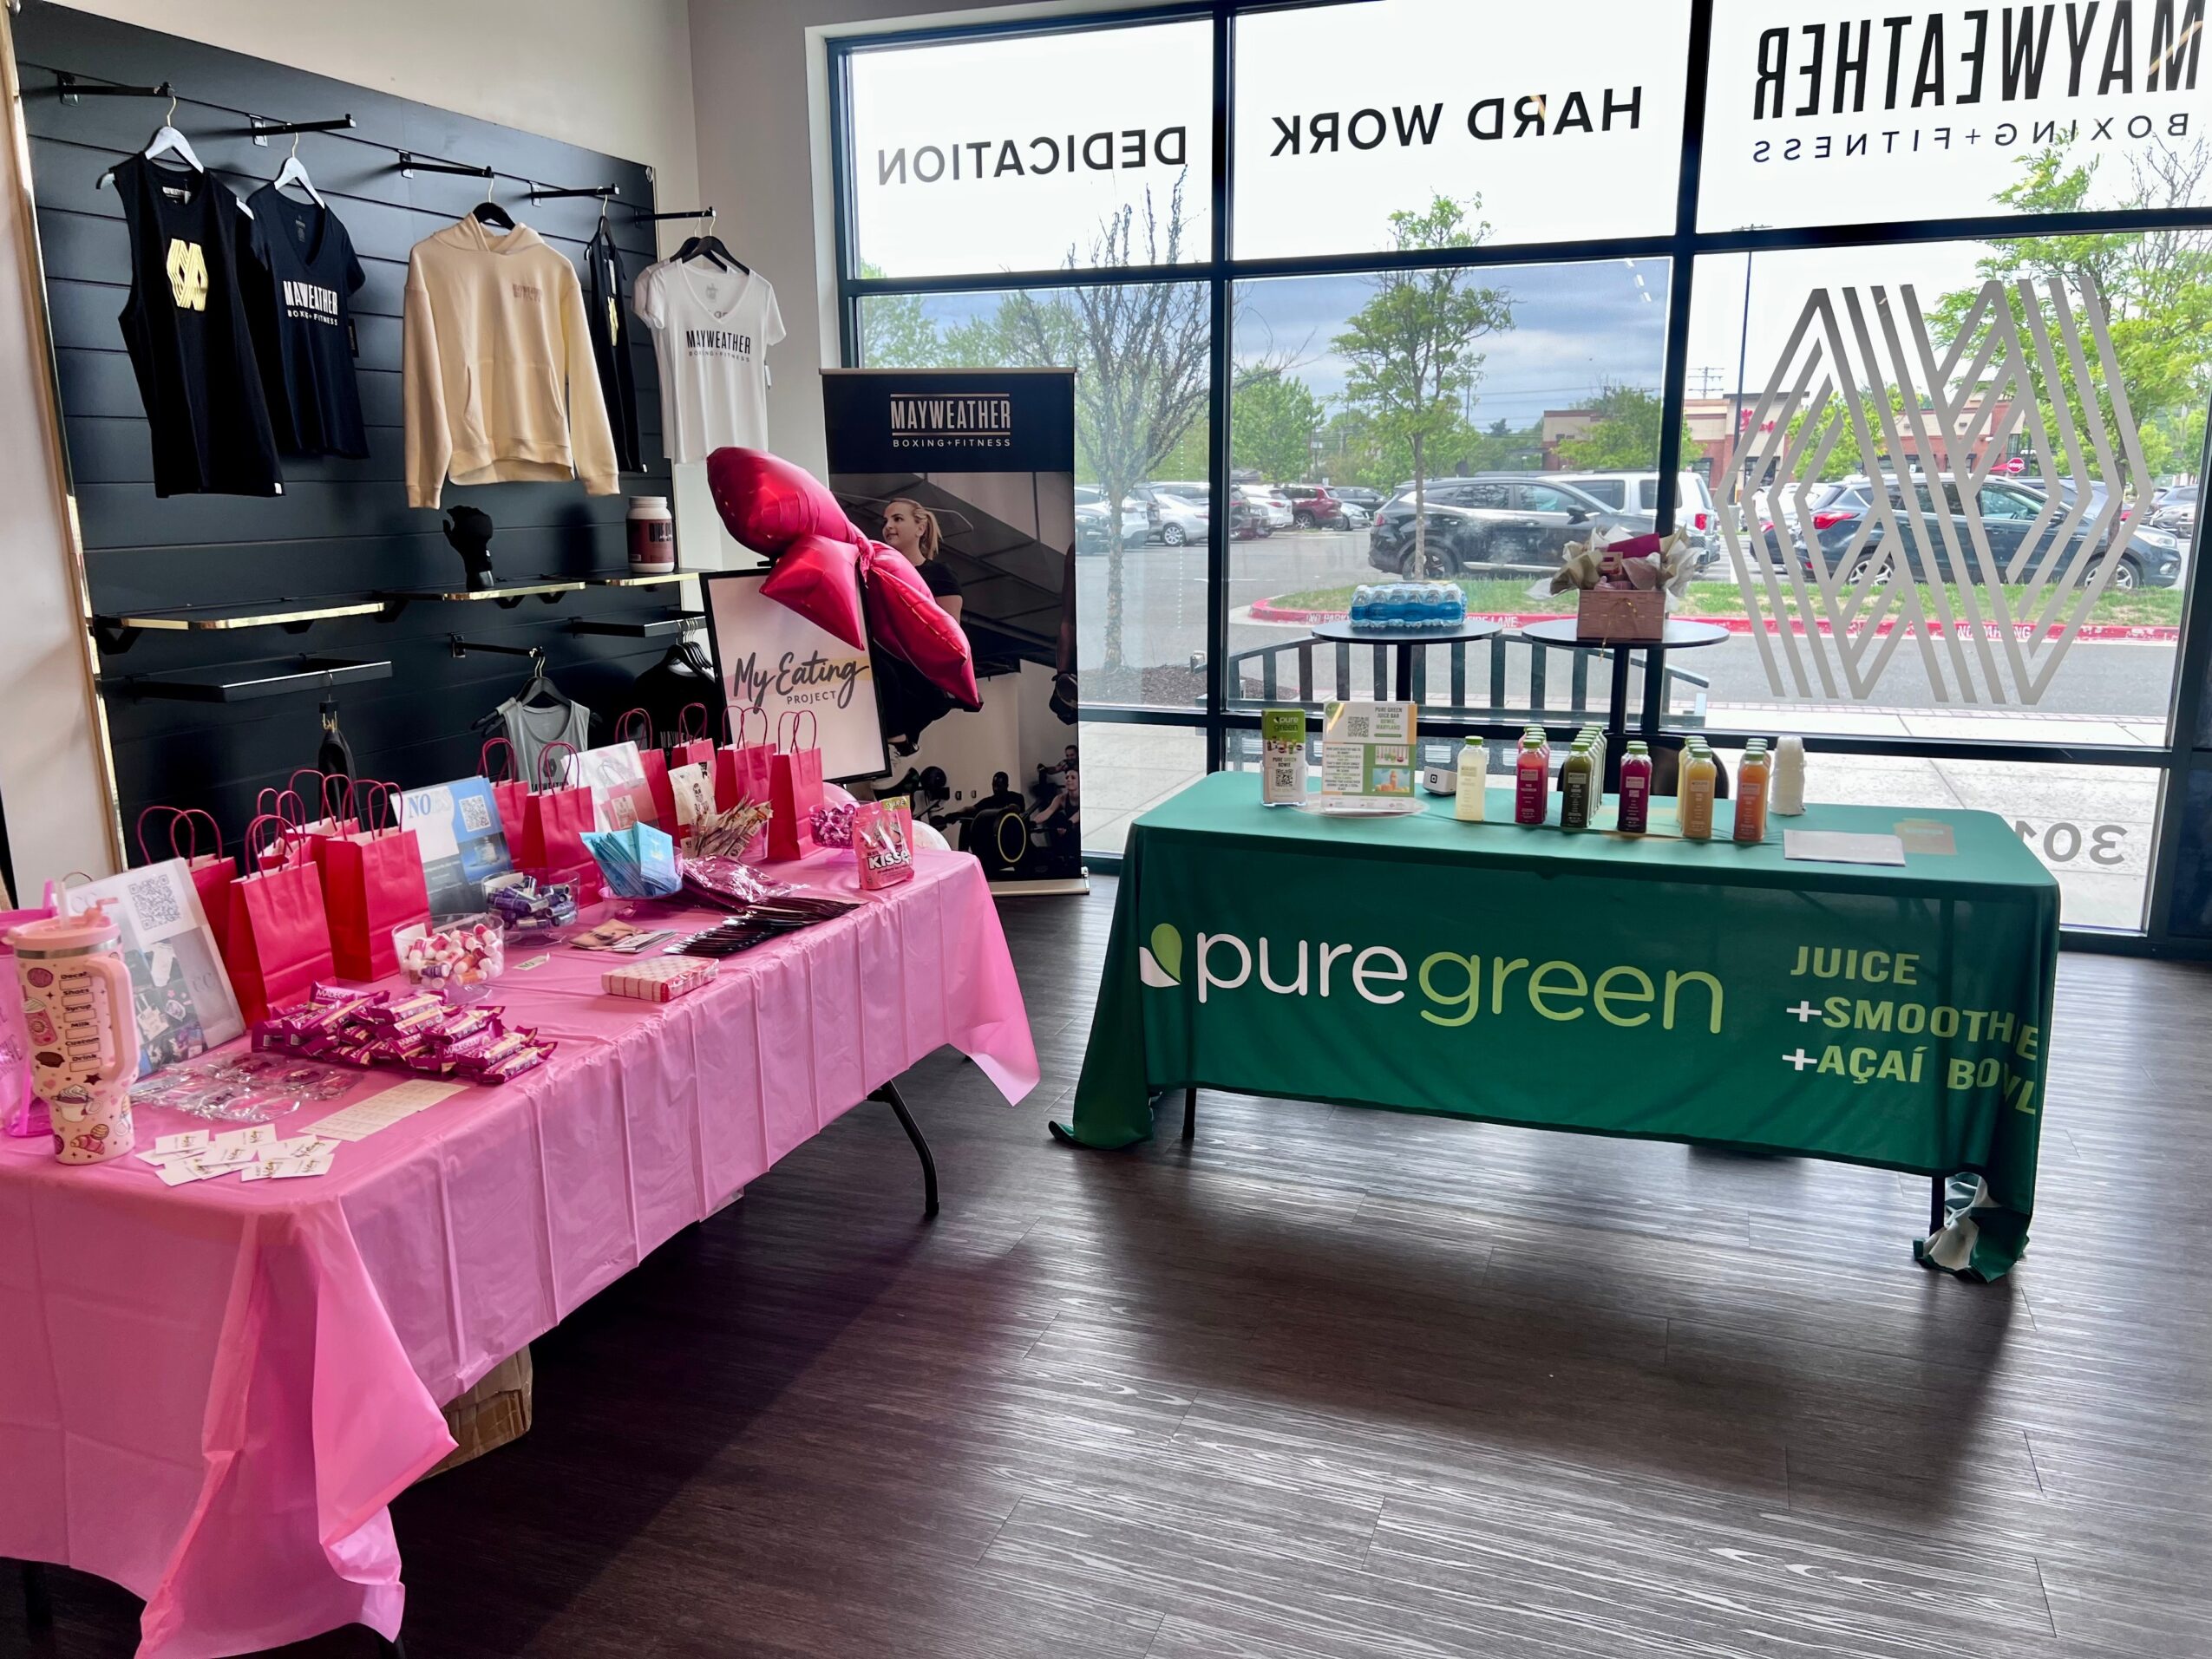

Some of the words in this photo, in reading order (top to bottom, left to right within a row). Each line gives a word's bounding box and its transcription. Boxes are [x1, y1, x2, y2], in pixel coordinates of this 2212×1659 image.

[686, 330, 751, 355] MAYWEATHER
[890, 400, 1011, 430] MAYWEATHER
[734, 652, 776, 715] My
[776, 650, 870, 709] Eating
[786, 690, 837, 705] PROJECT
[1279, 716, 1299, 725] pure
[1790, 946, 1920, 985] JUICE
